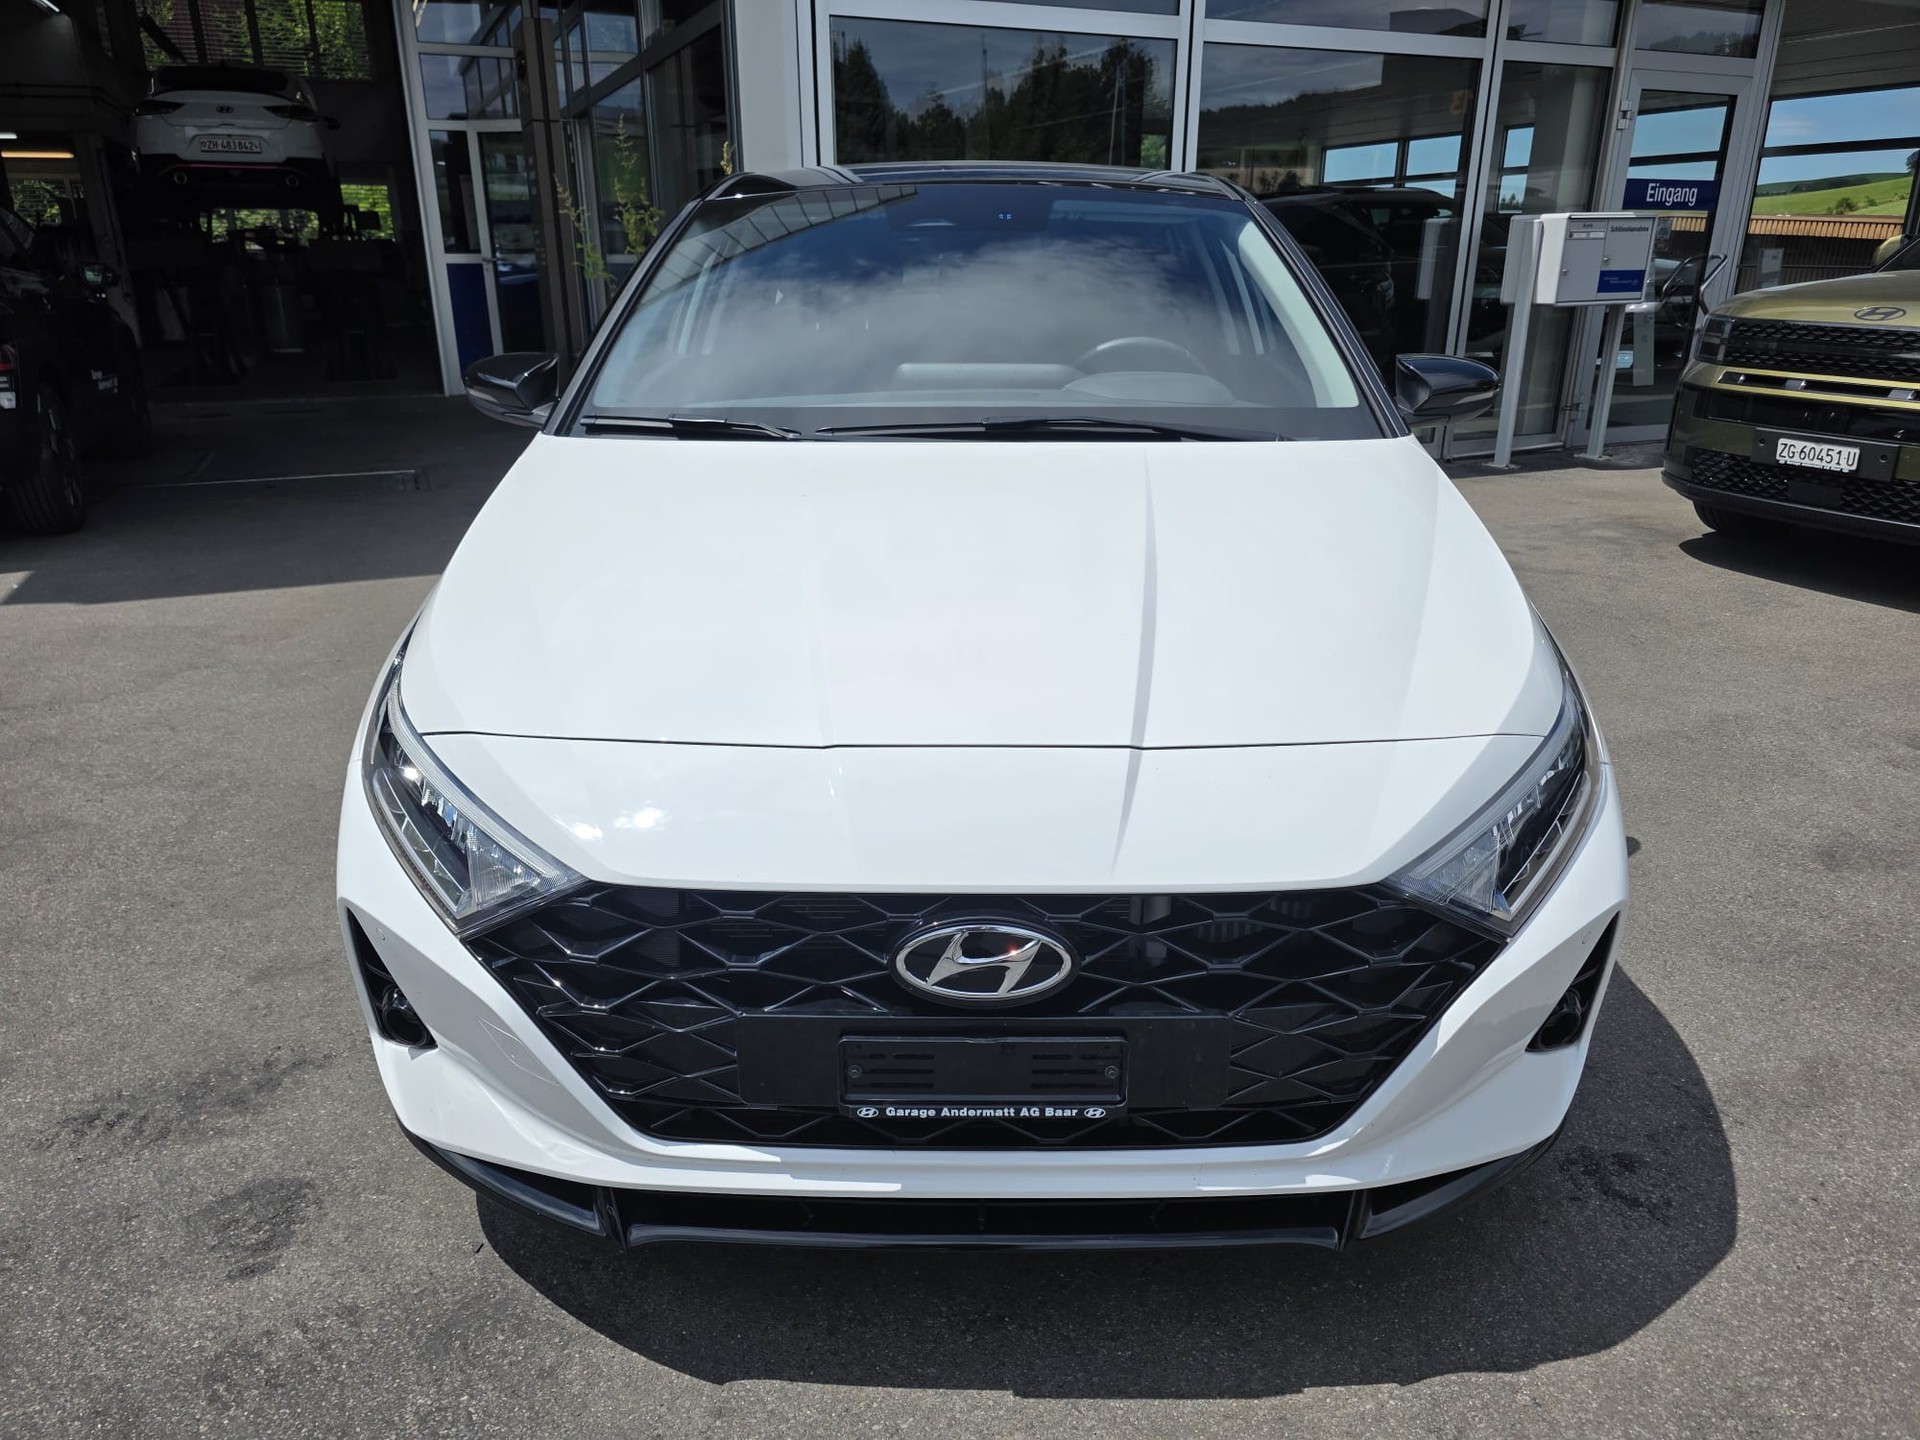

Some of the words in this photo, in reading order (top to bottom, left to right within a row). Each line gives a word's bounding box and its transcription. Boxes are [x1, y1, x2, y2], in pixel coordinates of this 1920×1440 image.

[1646, 182, 1698, 207] Eingang
[886, 1107, 936, 1118] Garage
[941, 1107, 1016, 1117] Andermatt
[1020, 1107, 1040, 1117] AG
[1045, 1107, 1079, 1117] Baar
